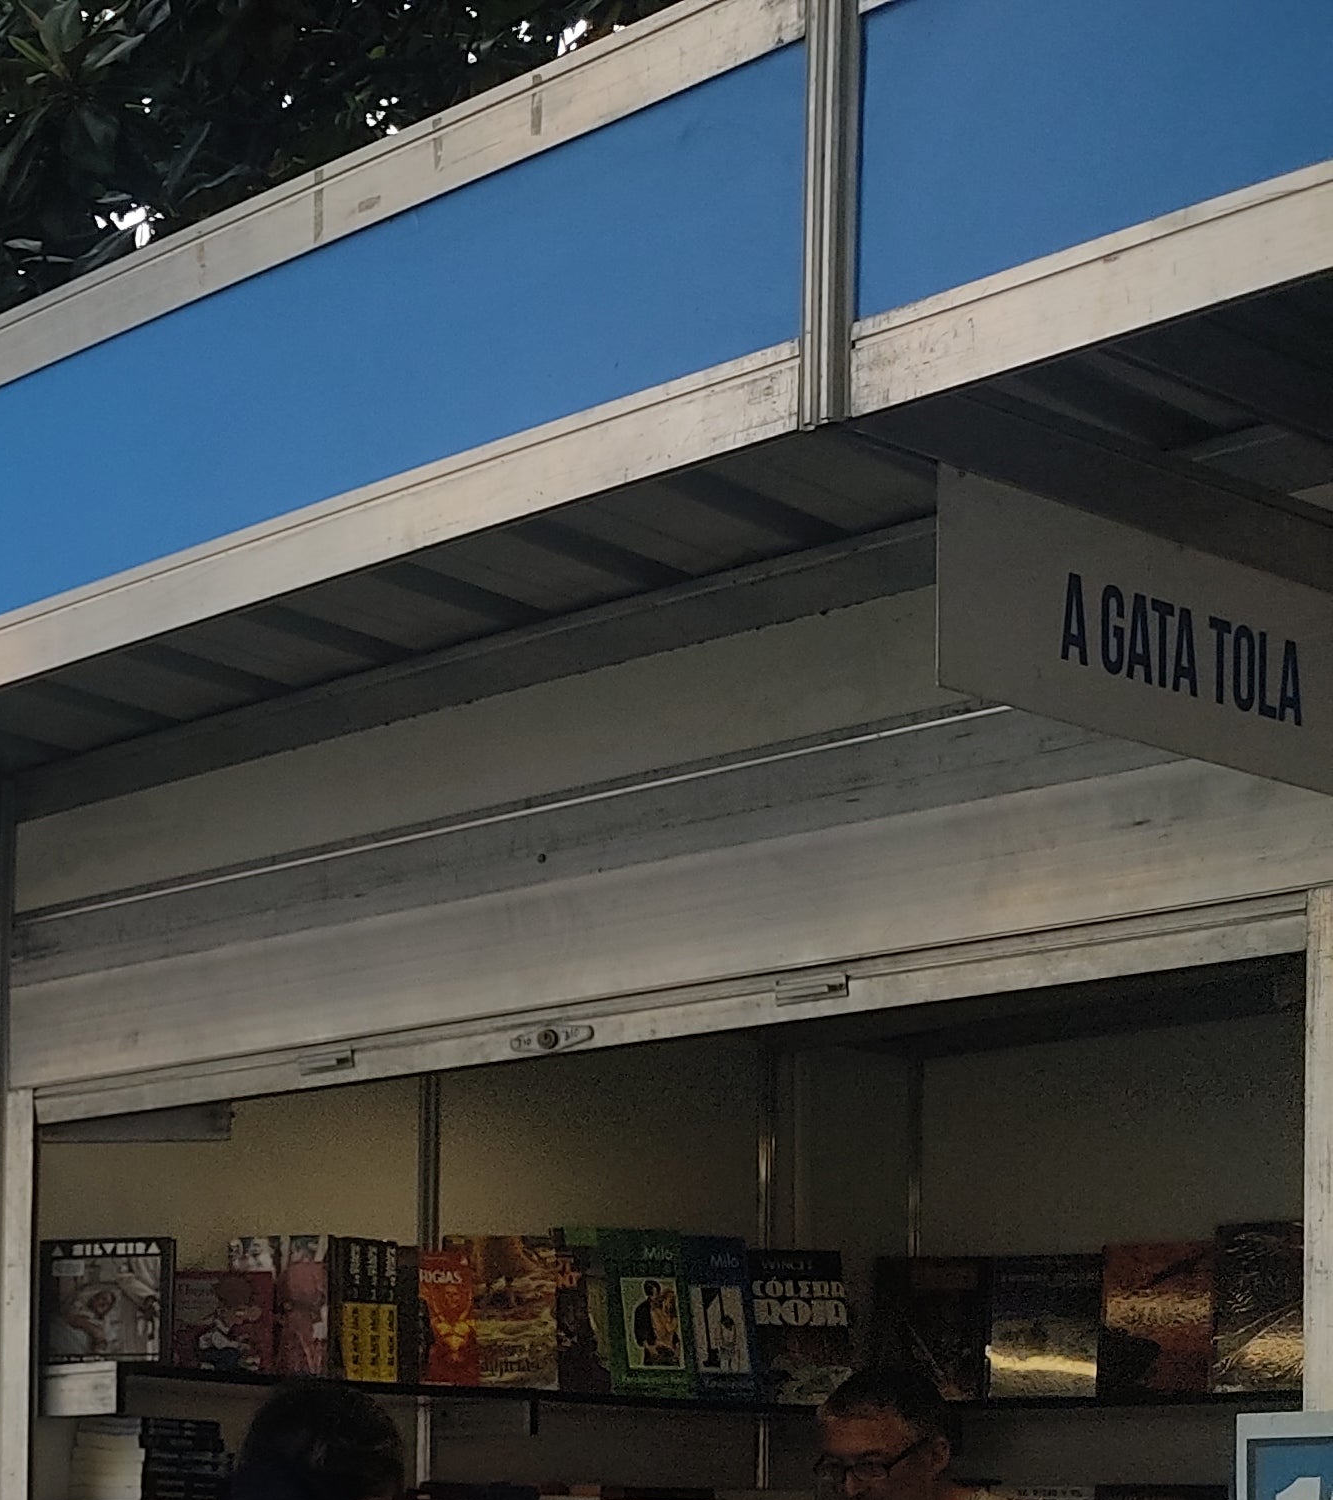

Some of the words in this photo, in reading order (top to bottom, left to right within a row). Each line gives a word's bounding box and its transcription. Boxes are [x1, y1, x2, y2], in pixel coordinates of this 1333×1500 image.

[1061, 572, 1088, 666] A
[1102, 585, 1197, 697] GATA
[1209, 616, 1302, 726] TOLA
